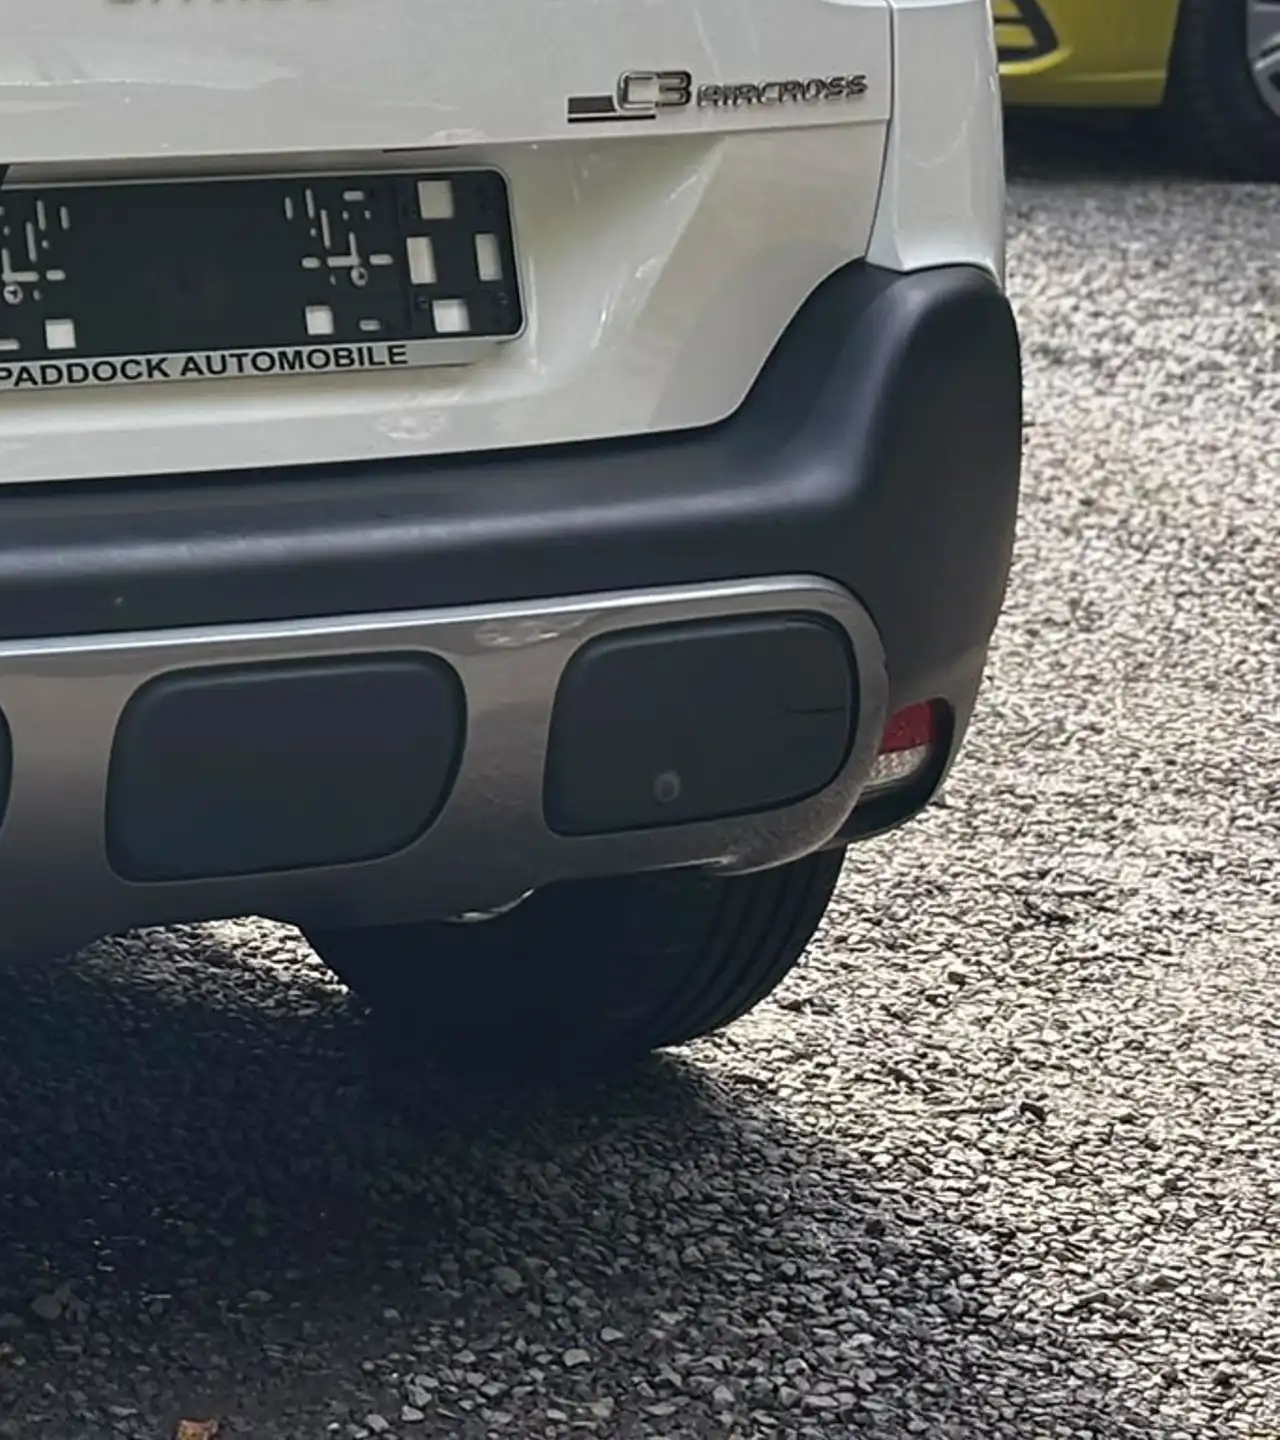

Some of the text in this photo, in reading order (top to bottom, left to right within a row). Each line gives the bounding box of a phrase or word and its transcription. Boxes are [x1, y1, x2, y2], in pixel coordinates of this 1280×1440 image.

[616, 69, 868, 109] C3 AIRCROSS
[179, 344, 409, 377] AUTOMOBILE
